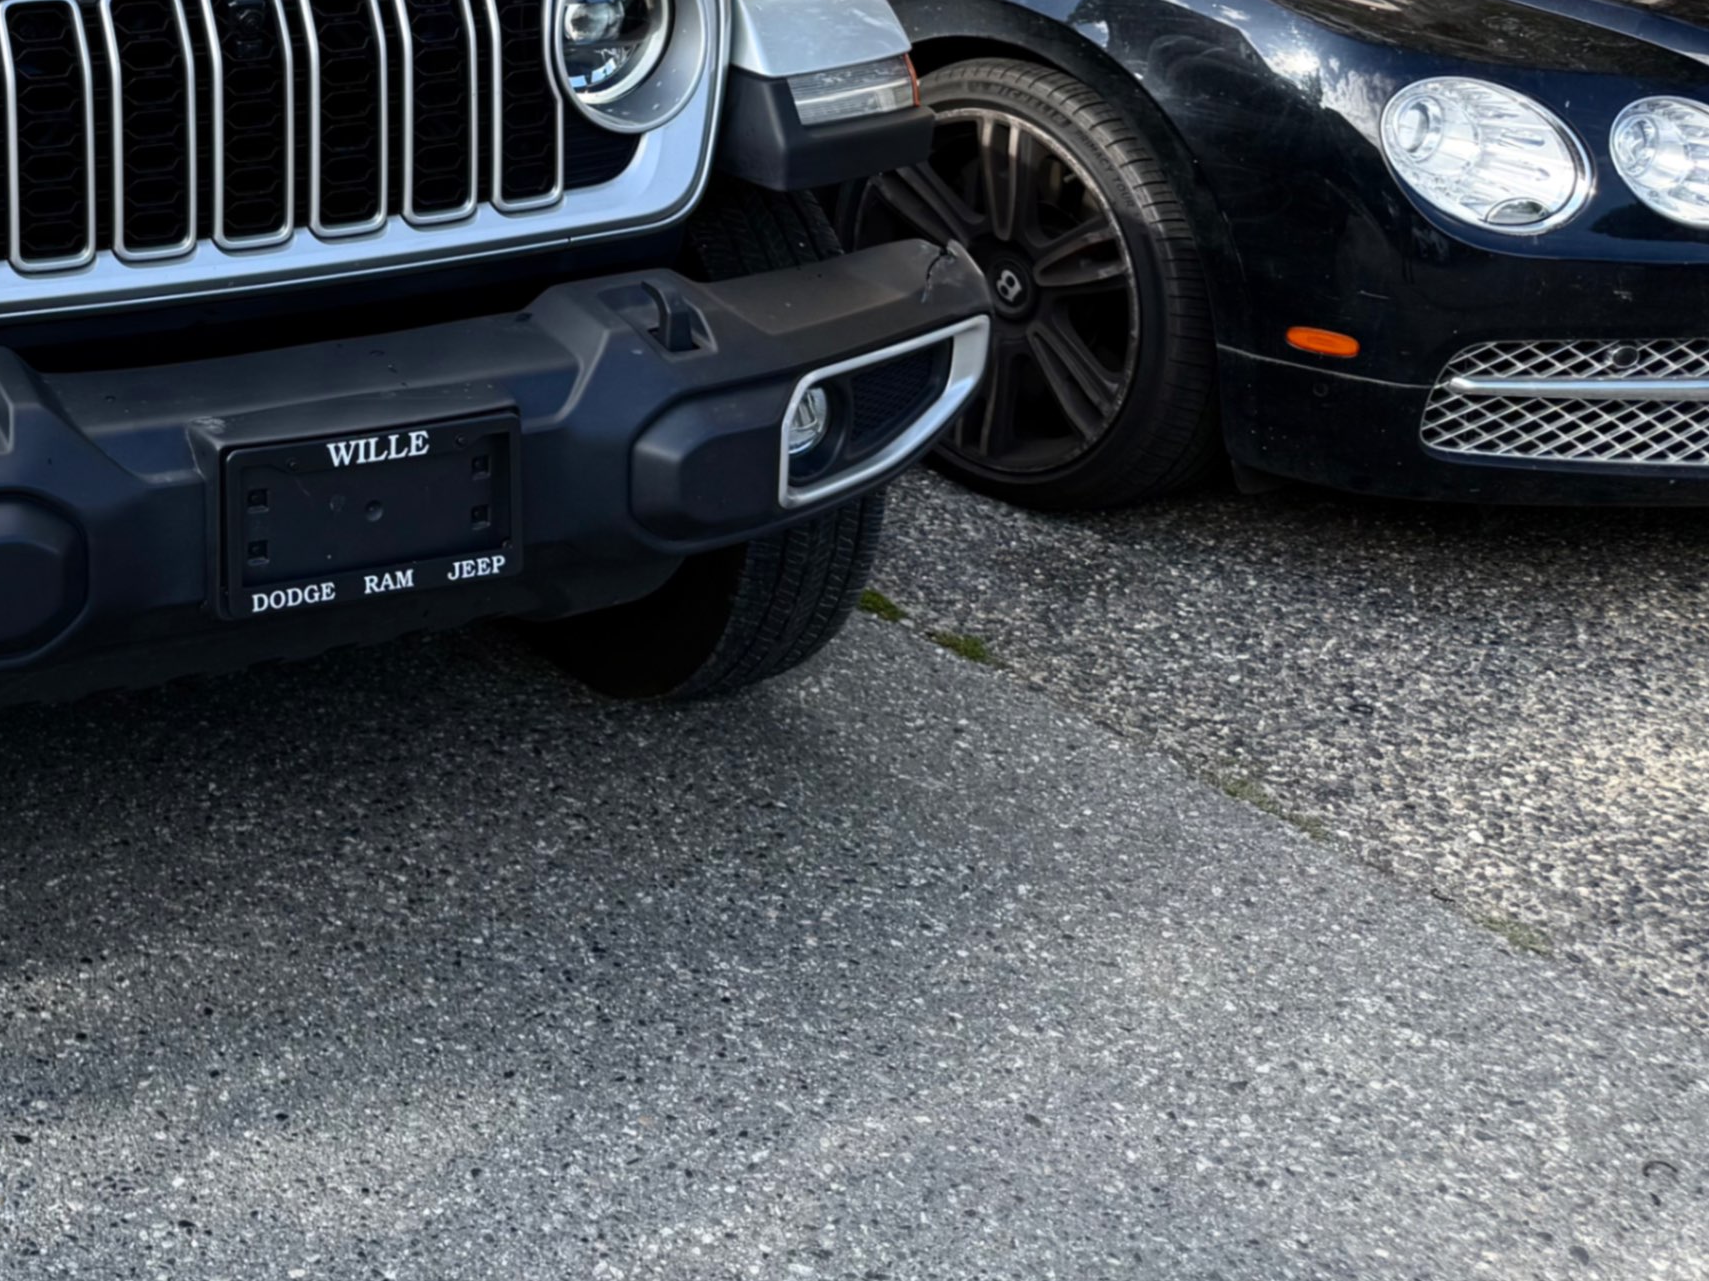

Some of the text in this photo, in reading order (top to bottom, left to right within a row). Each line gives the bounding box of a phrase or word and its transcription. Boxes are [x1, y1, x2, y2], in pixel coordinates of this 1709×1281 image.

[1075, 128, 1136, 208] PRIMACY TOUR
[326, 430, 430, 467] WILLE
[251, 554, 506, 613] DODGE RAM JEEP
